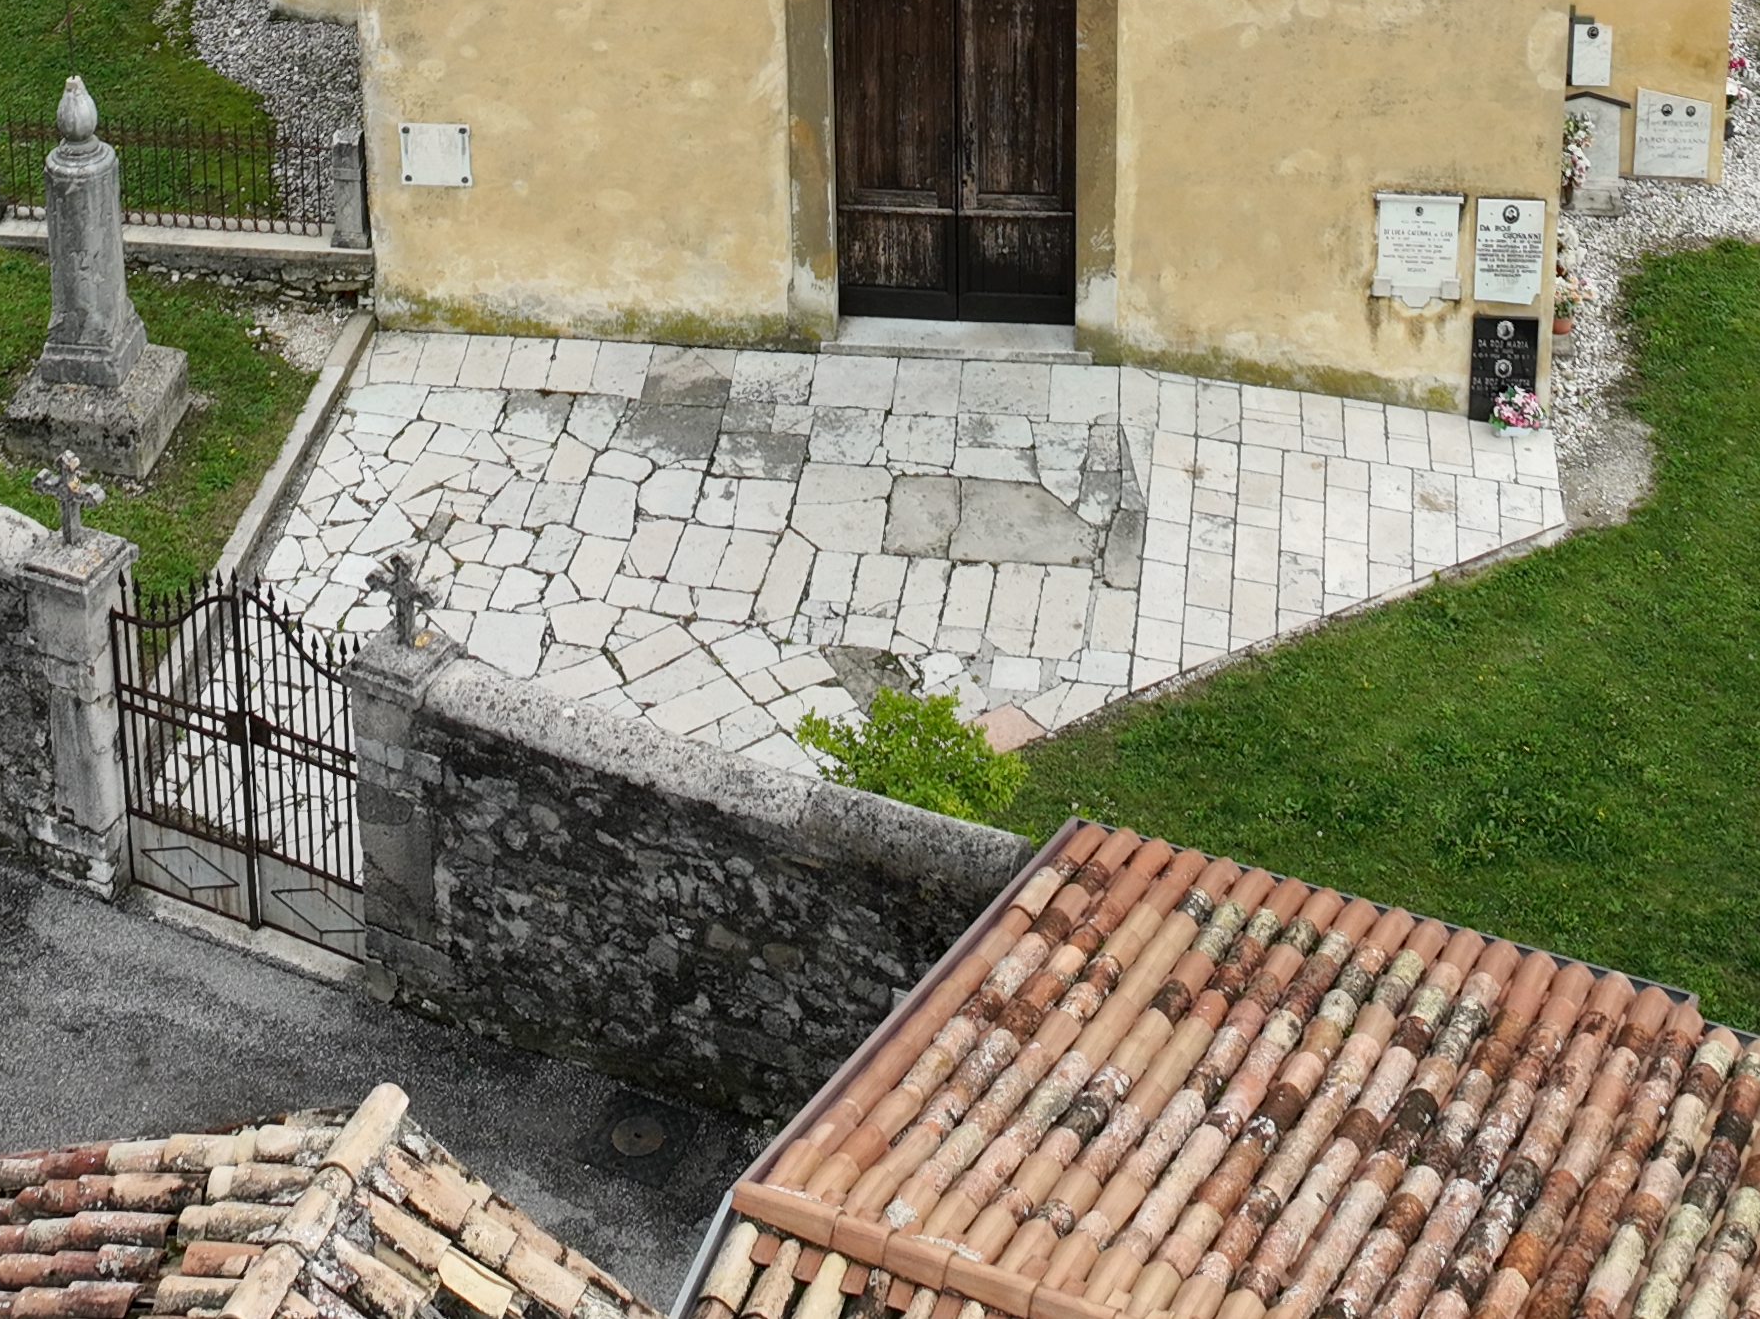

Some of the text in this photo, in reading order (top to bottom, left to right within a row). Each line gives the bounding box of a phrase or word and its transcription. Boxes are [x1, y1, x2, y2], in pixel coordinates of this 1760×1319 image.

[1479, 224, 1490, 232] DA
[1503, 232, 1541, 240] GIOVANNI
[1478, 339, 1529, 349] DA ROS MARIA
